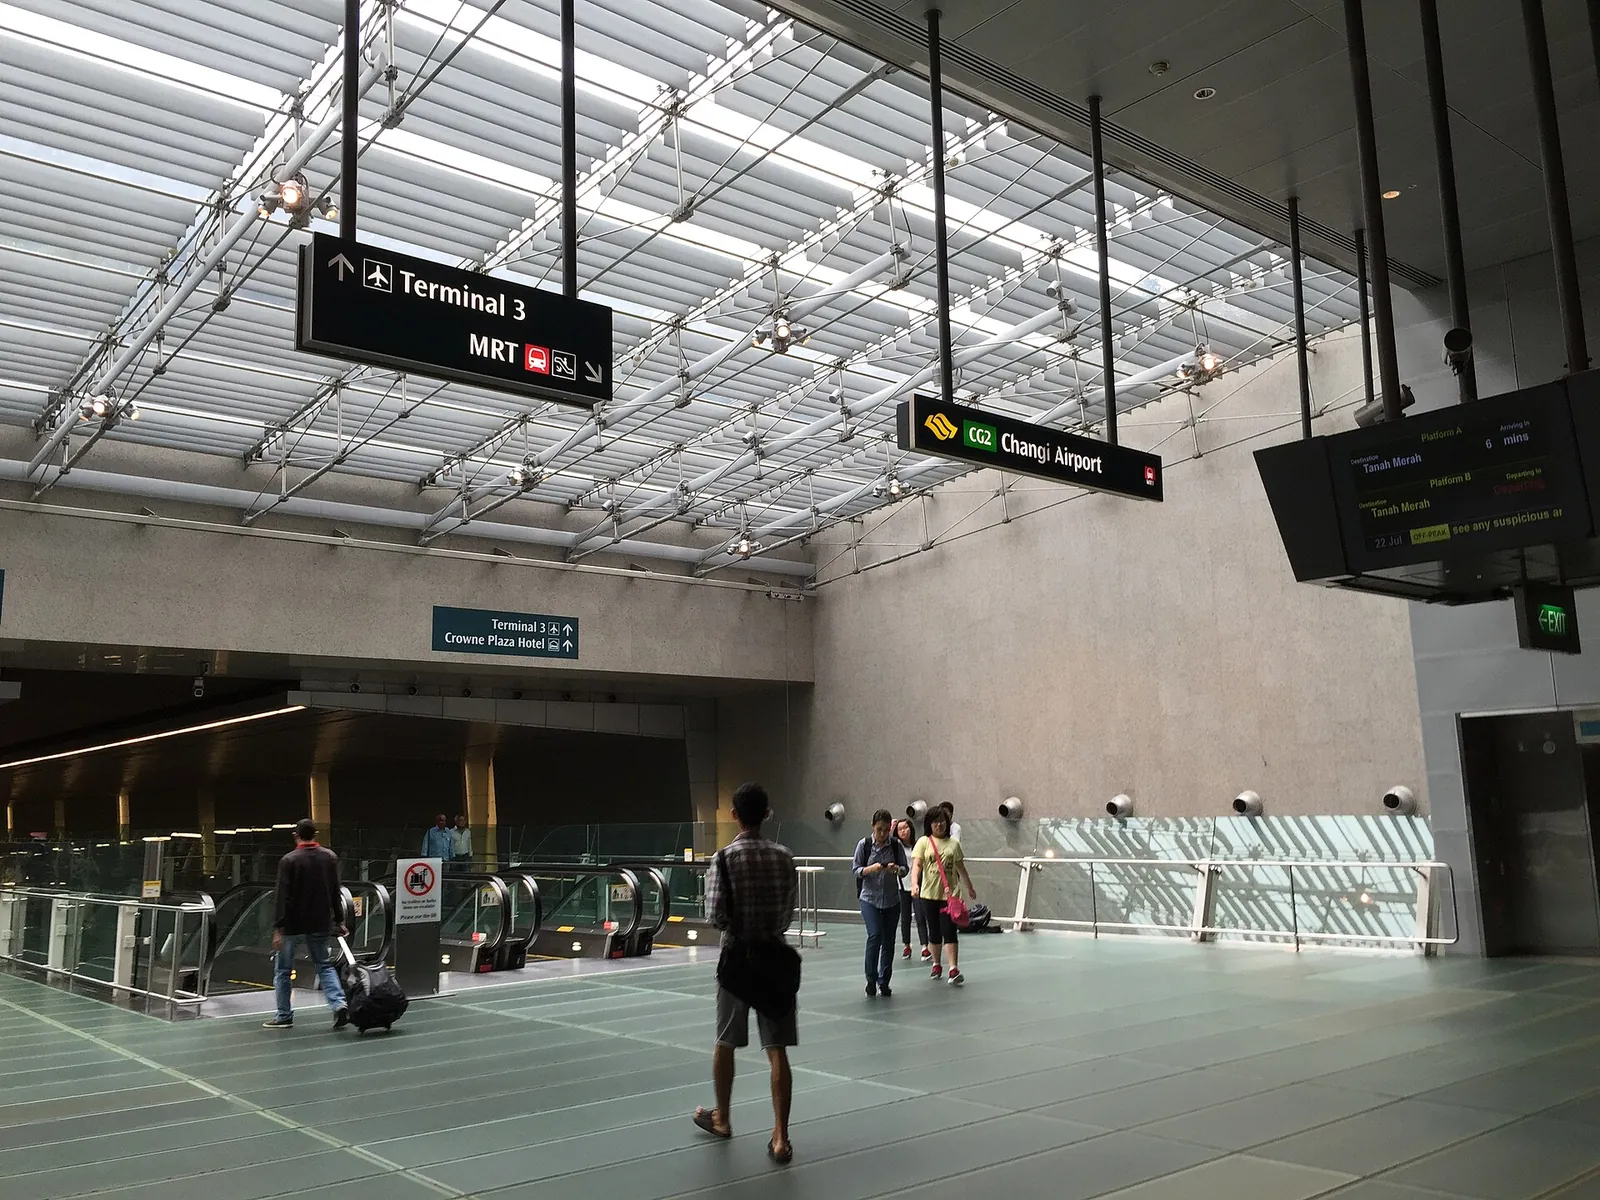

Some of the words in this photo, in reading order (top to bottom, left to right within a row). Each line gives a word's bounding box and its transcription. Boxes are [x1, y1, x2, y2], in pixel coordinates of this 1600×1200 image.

[399, 270, 505, 317] Terminal
[512, 299, 526, 321] 3
[469, 333, 519, 363] MRT
[1421, 429, 1455, 442] Platform
[1456, 426, 1463, 435] A
[1500, 420, 1523, 432] Arriving
[1485, 438, 1493, 449] 6
[1503, 432, 1529, 446] mins
[968, 426, 992, 446] CG2
[1001, 432, 1050, 464] Changi
[1055, 445, 1102, 474] Airport
[1363, 460, 1391, 474] Tanah
[1392, 453, 1422, 468] Merah
[1429, 475, 1464, 488] Platform
[1464, 472, 1472, 481] B
[1506, 469, 1535, 480] Departing
[1371, 504, 1399, 518] Tanah
[1401, 499, 1430, 513] Merah
[1452, 523, 1470, 535] see
[1472, 520, 1491, 532] any
[1493, 510, 1550, 528] suspicious
[1375, 538, 1386, 549] 22
[1388, 534, 1403, 546] Jul
[1413, 529, 1447, 541] OFF-PEAK
[491, 618, 537, 633] Terminal
[539, 622, 546, 633] 3
[1548, 610, 1566, 633] EXIT
[444, 632, 485, 646] Crowne
[487, 635, 515, 648] Plaza
[518, 637, 545, 650] Hotel
